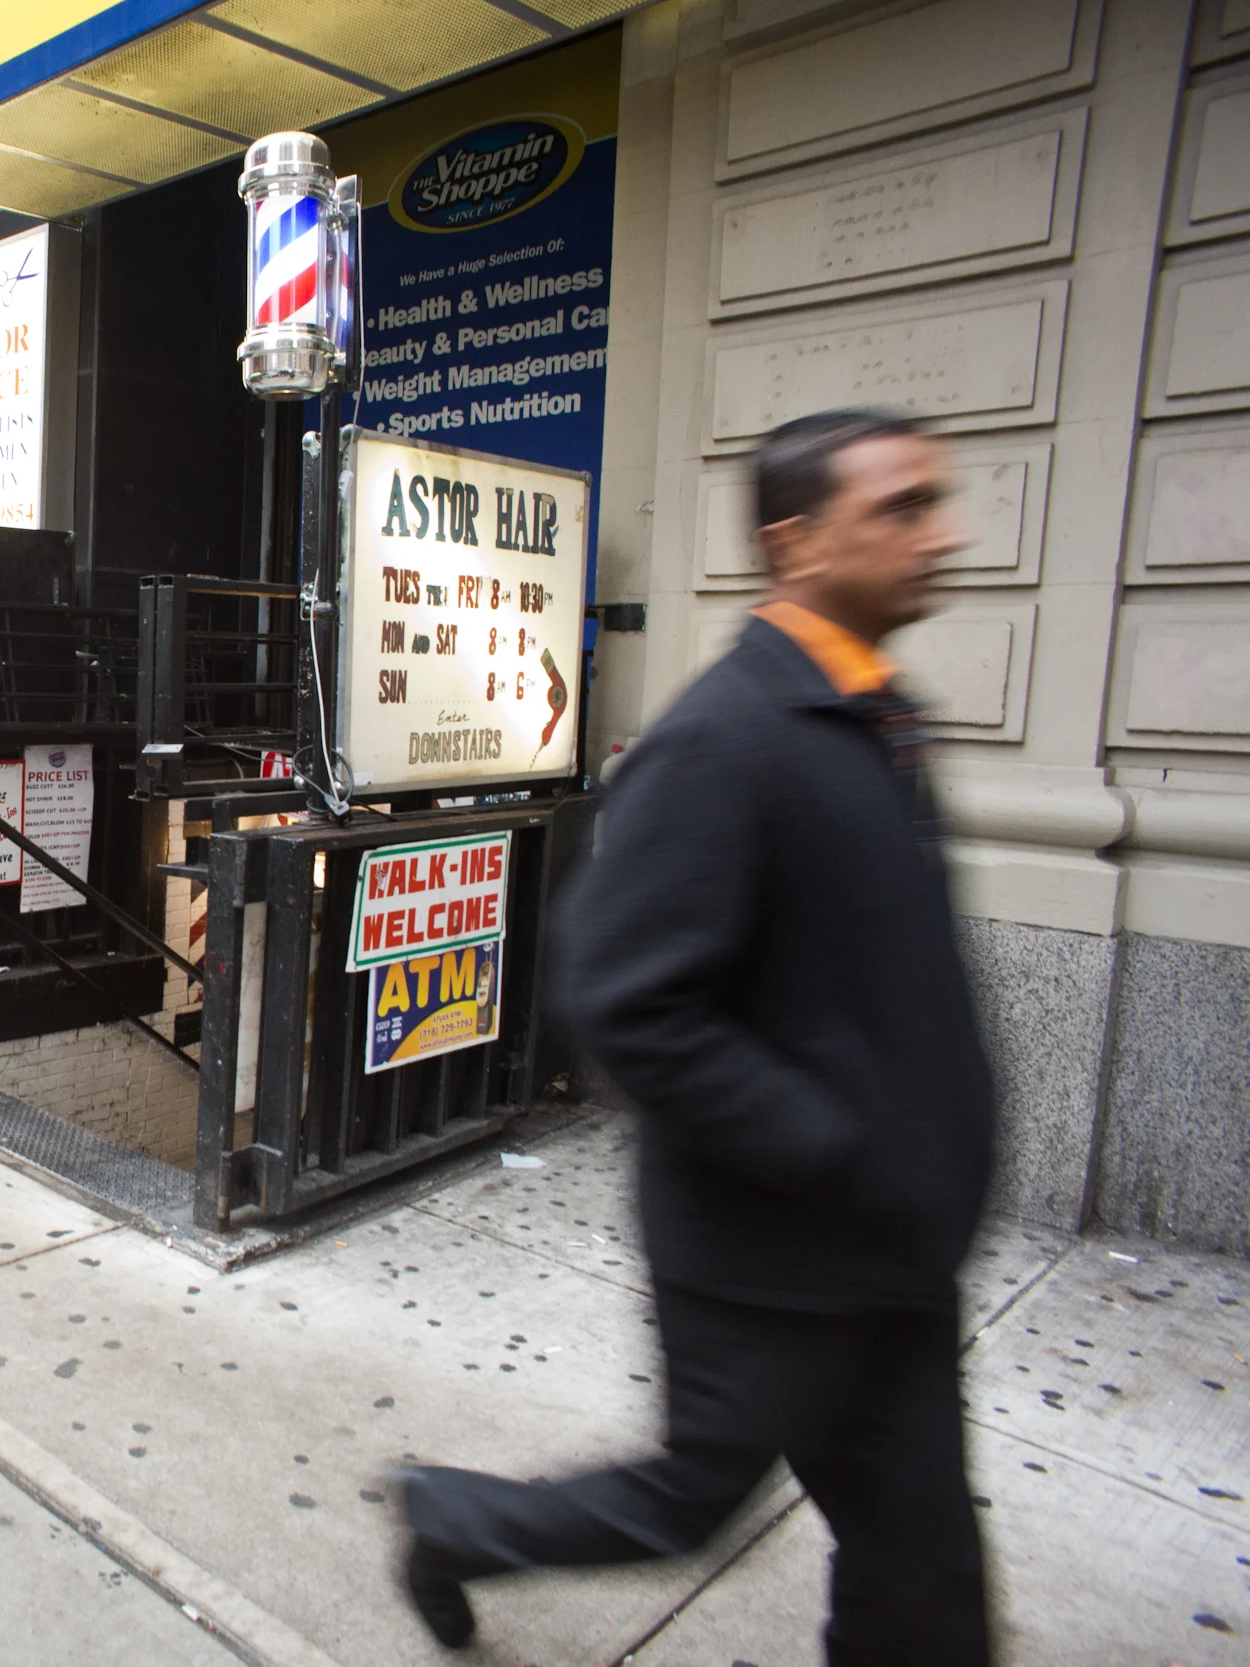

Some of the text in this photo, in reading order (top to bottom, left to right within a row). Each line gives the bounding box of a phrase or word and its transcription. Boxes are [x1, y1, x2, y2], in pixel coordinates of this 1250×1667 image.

[436, 132, 555, 183] Vitamin
[413, 161, 539, 212] THE Shoppe
[446, 197, 516, 225] SINCE 1977
[399, 238, 565, 287] We Have a Huge Selection Of:
[378, 267, 604, 331] Health & Wellness
[362, 339, 427, 368] eauty
[432, 332, 451, 355] &
[458, 310, 563, 351] Personal
[364, 369, 441, 403] Weight
[388, 392, 581, 437] Sports Nutrition
[381, 468, 557, 557] ASTOR HAIR
[382, 566, 420, 605] TUES
[458, 575, 480, 609] FRI
[381, 620, 405, 654] MON
[412, 633, 430, 654] AND
[436, 623, 458, 655] SAT
[488, 627, 497, 655] 8
[518, 628, 526, 656] 8
[378, 669, 407, 704] SUN
[486, 672, 496, 701] 8
[516, 671, 525, 700] 6
[437, 709, 470, 725] Enter
[408, 727, 502, 765] DOWNSTAIRS
[28, 770, 89, 782] PRICE LIST
[368, 845, 503, 900] WALK-INS
[363, 893, 498, 952] WELCOME
[377, 947, 476, 1017] ATM
[419, 1027, 438, 1041] (718)
[433, 1013, 449, 1023] ATLAS
